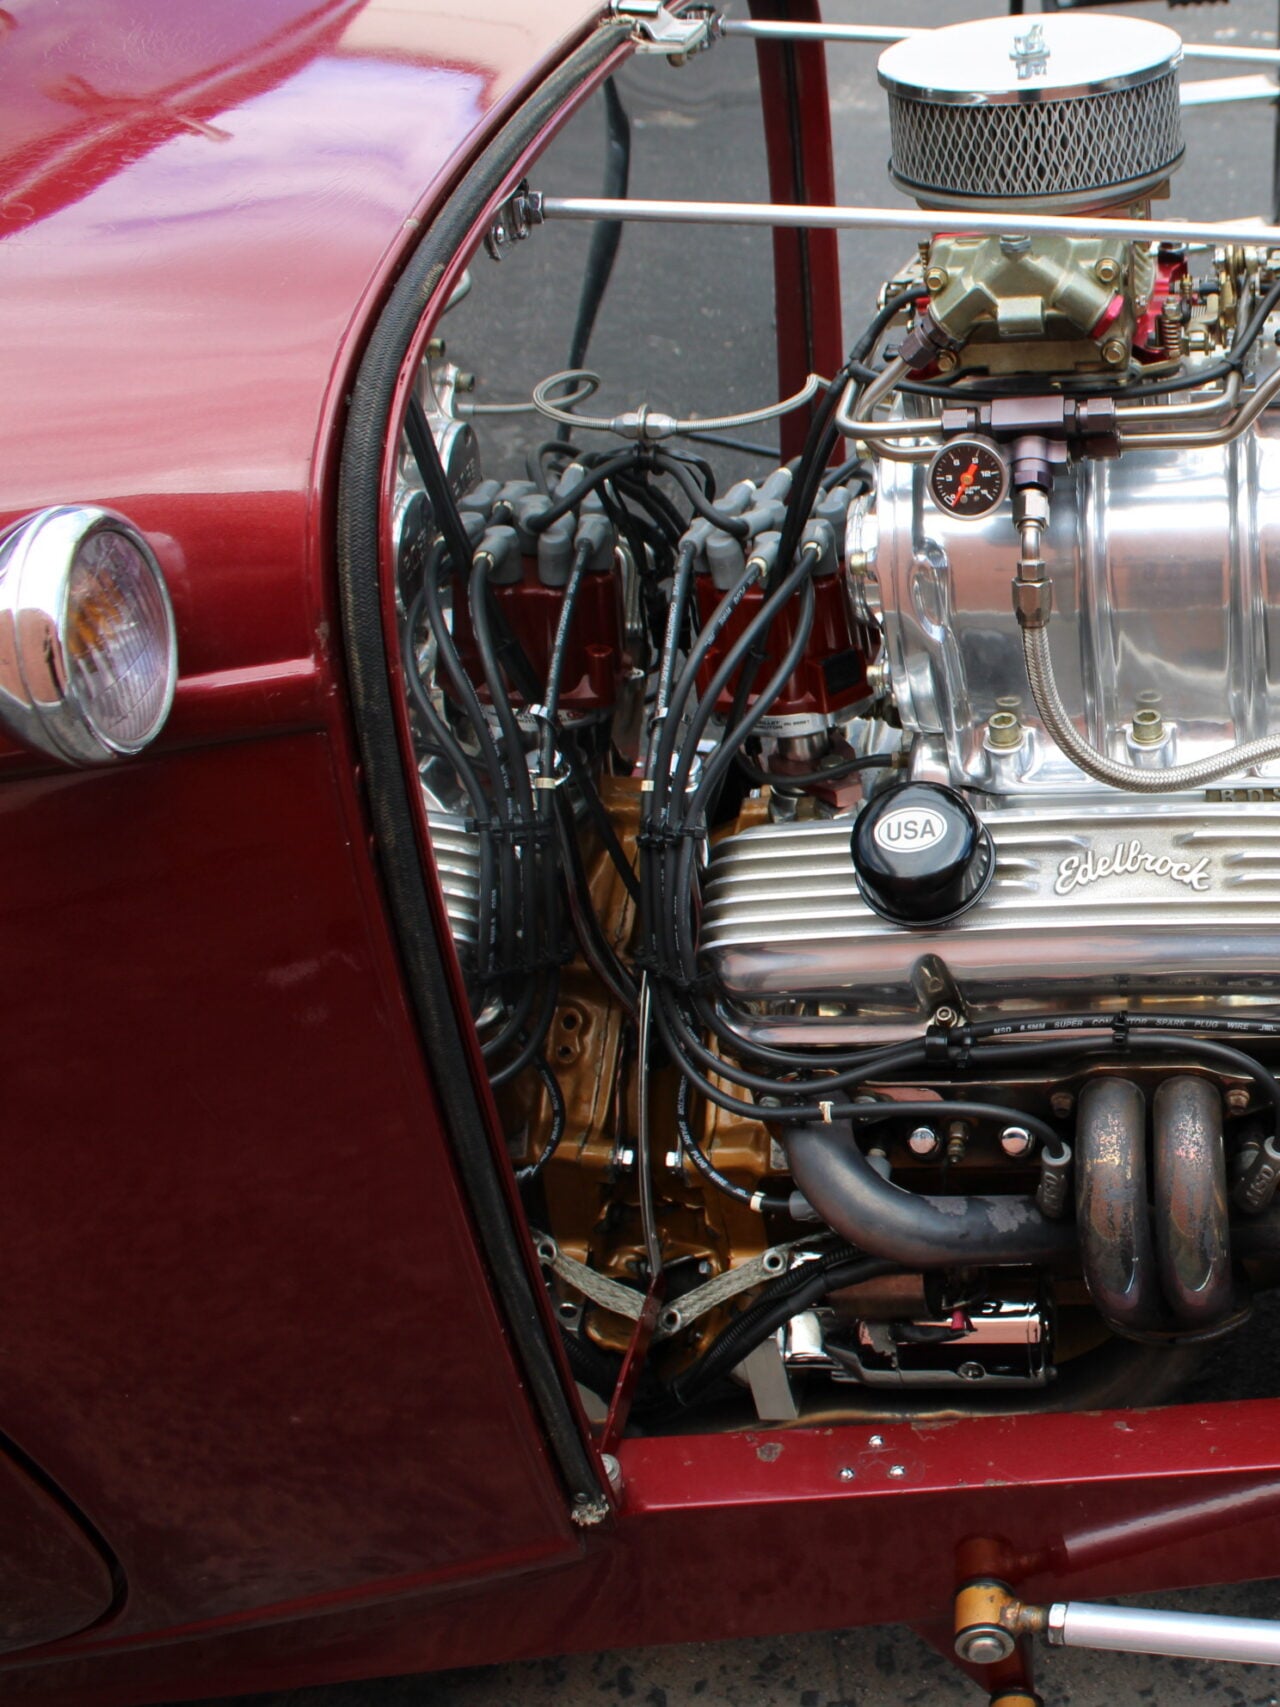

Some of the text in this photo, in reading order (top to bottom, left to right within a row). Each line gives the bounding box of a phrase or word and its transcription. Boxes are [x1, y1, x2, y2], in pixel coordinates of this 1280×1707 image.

[886, 818, 937, 843] USA
[1053, 839, 1212, 896] Edelbrock
[993, 1026, 1012, 1035] MSD
[1054, 1019, 1084, 1029] SUPER
[1155, 1018, 1186, 1027] SPARK
[1193, 1020, 1219, 1029] PLUG
[1226, 1021, 1250, 1031] WIRE
[679, 1120, 693, 1145] SPARK
[690, 1149, 709, 1169] PLUG
